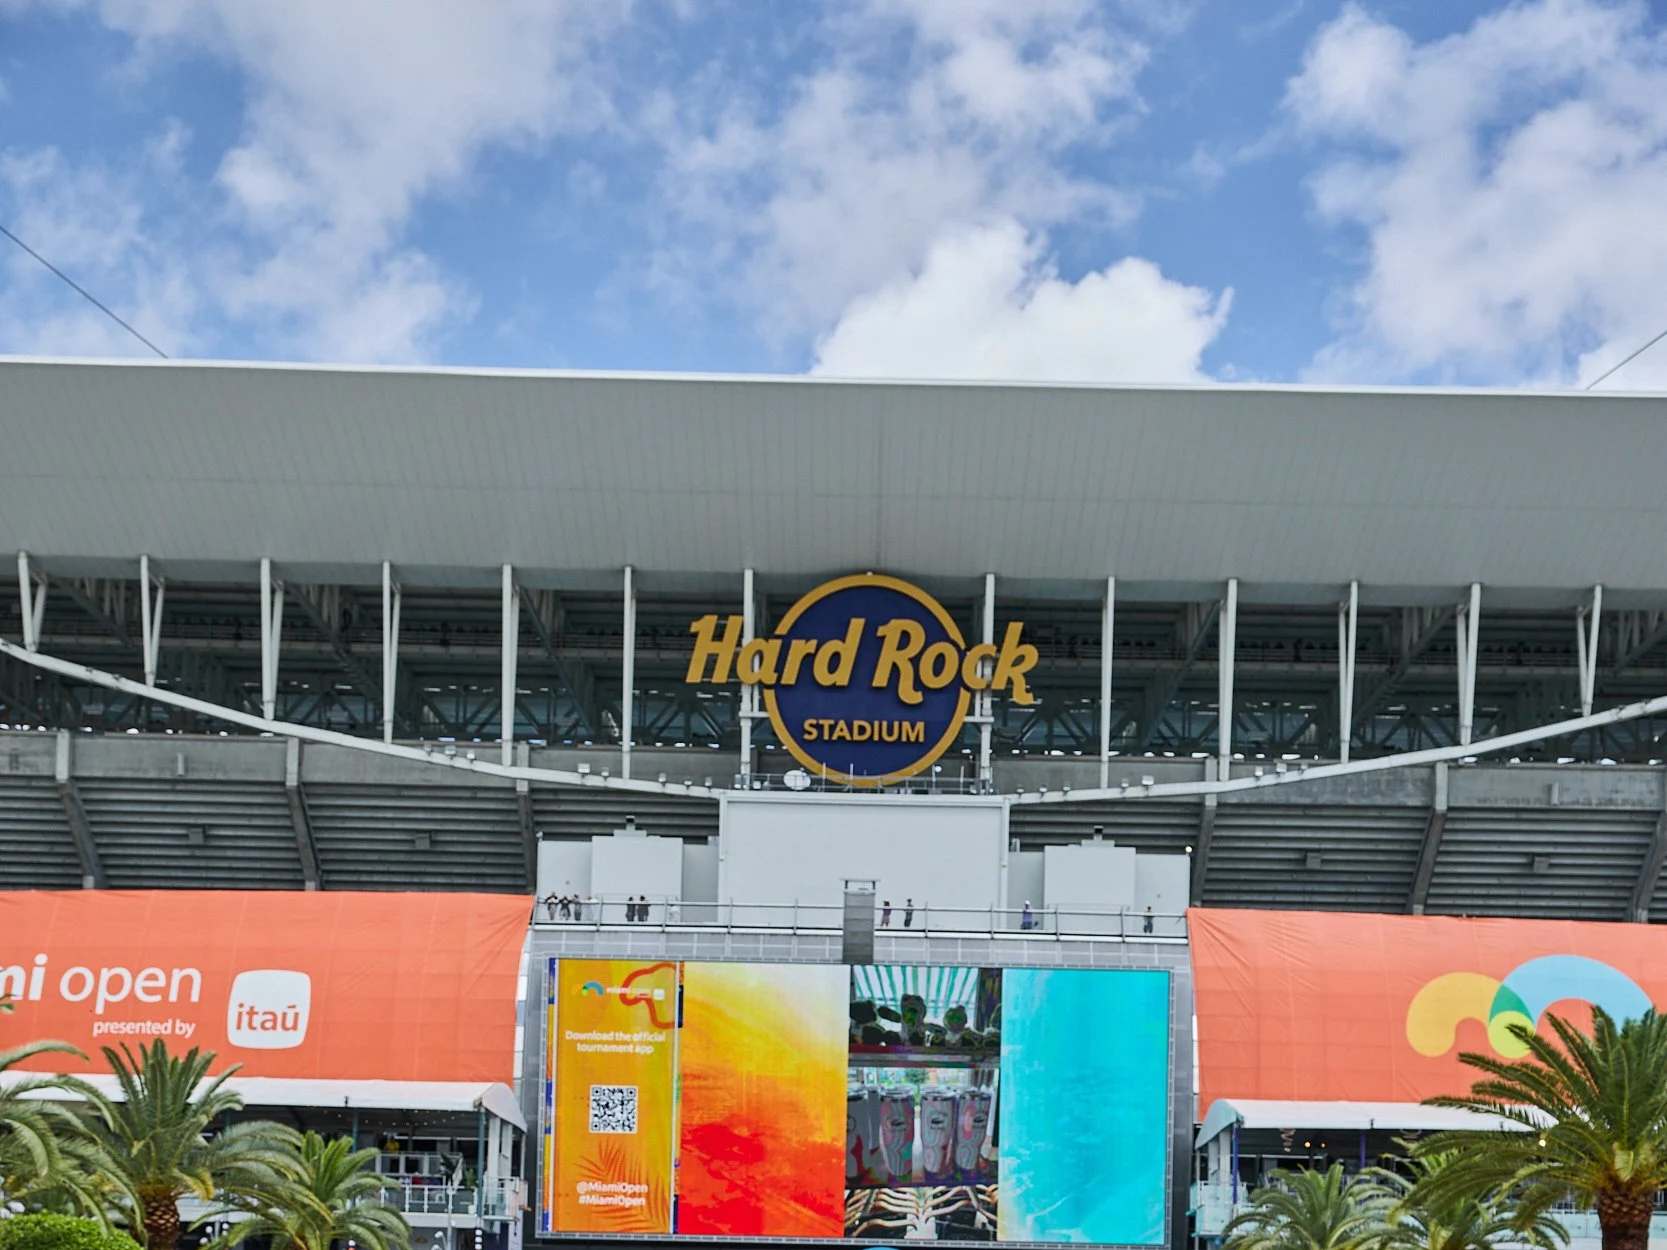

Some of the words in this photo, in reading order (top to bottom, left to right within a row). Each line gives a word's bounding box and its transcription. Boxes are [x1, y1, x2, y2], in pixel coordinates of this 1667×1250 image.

[685, 614, 866, 687] Hard
[871, 618, 1040, 706] Rock
[803, 718, 926, 743] STADIUM
[60, 966, 202, 1015] open
[236, 1003, 299, 1031] itaú
[92, 1018, 173, 1038] presented
[175, 1018, 196, 1039] by
[565, 1030, 614, 1041] Download
[615, 1031, 632, 1041] the
[632, 1031, 666, 1042] official
[576, 1042, 633, 1053] tournament
[635, 1045, 654, 1055] app
[577, 1181, 648, 1195] @MiamiOpen
[579, 1194, 646, 1208] #MiamiOpen
